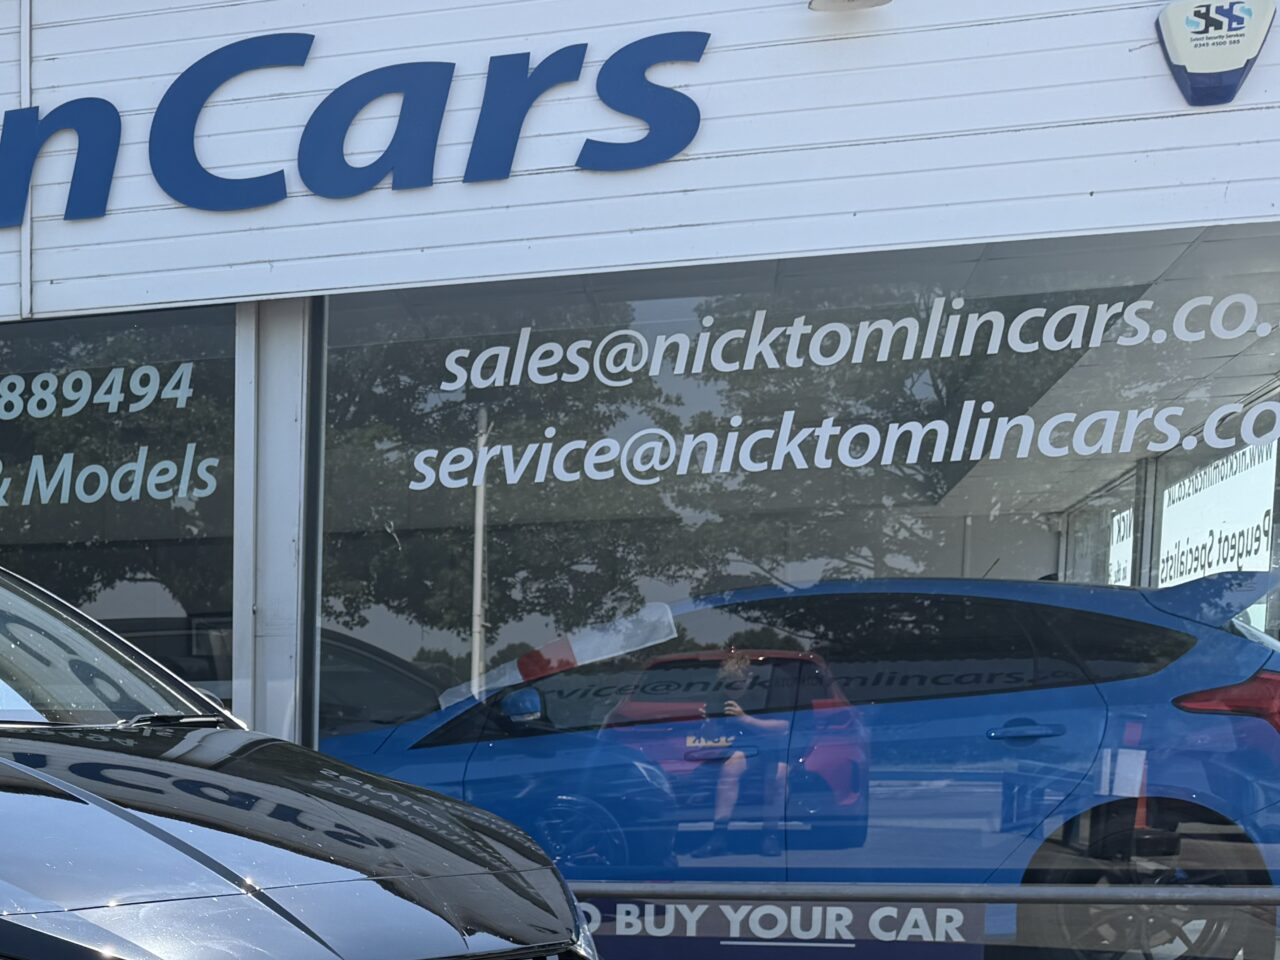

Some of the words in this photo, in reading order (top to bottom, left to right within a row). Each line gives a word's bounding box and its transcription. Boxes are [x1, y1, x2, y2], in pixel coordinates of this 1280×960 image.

[22, 443, 219, 506] Models
[615, 903, 709, 937] BUY
[720, 904, 856, 940] YOUR
[868, 906, 965, 942] CAR
